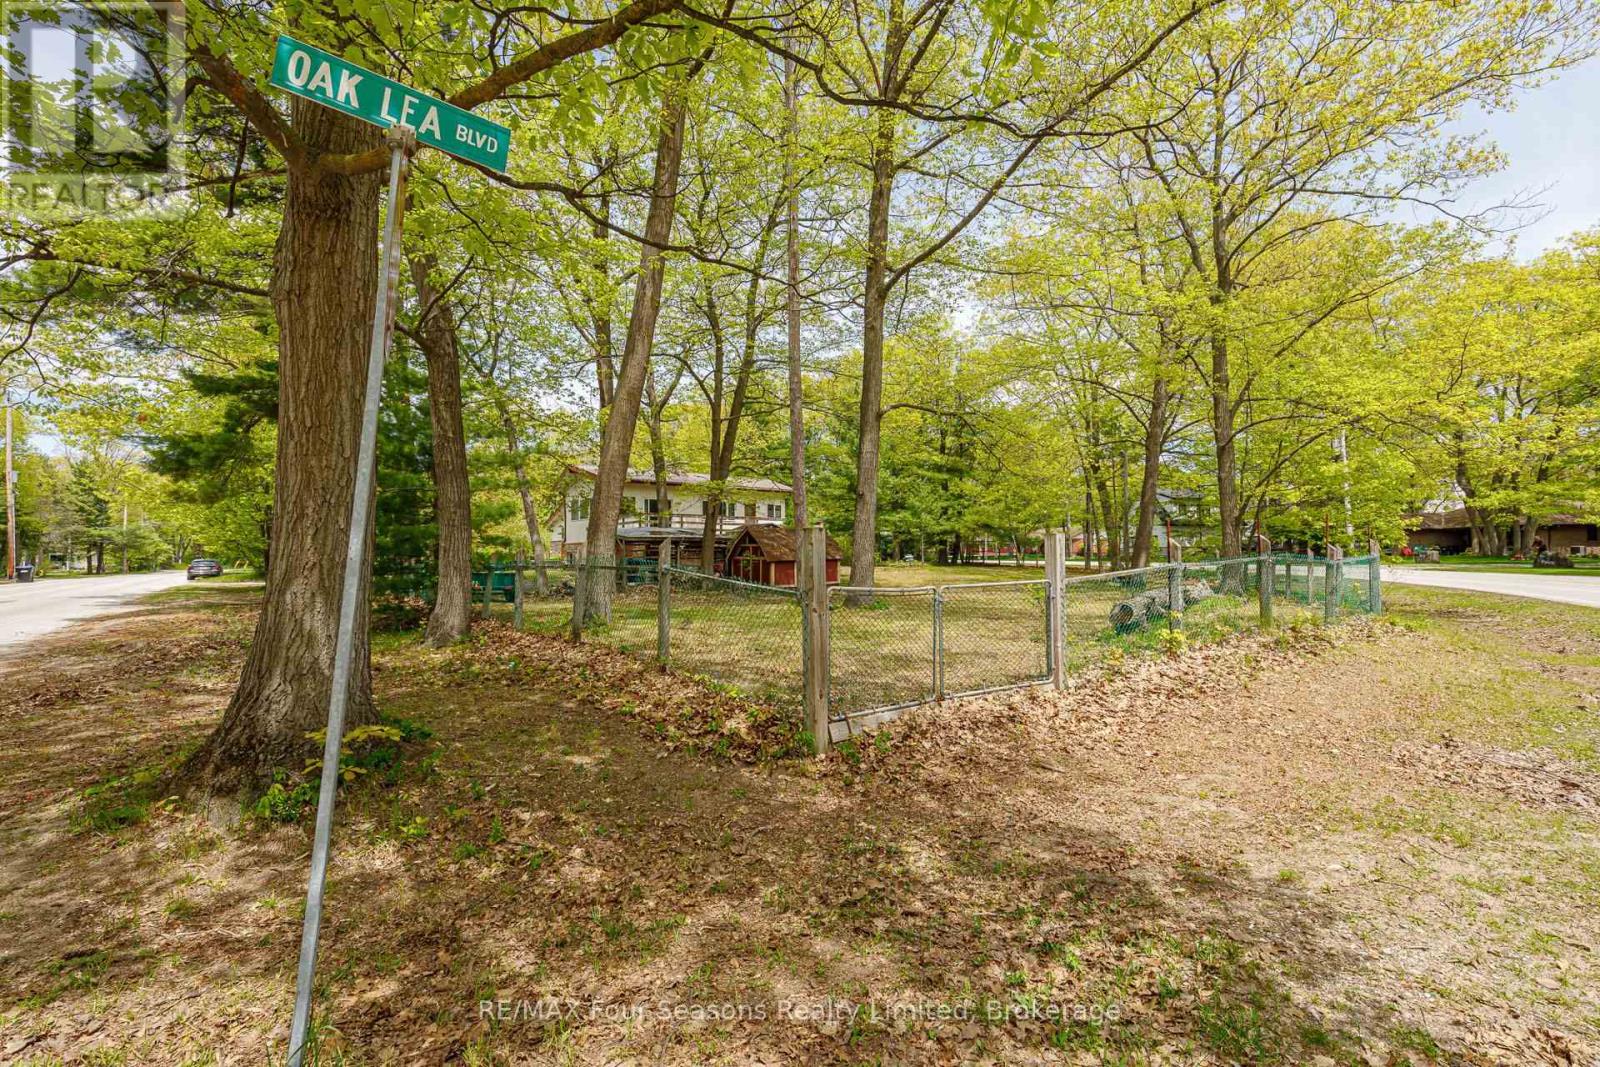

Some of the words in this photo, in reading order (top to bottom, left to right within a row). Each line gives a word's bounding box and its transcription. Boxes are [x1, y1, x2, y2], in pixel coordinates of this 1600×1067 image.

[287, 50, 363, 109] OAK
[380, 87, 442, 141] LEA
[454, 124, 499, 154] BLVD
